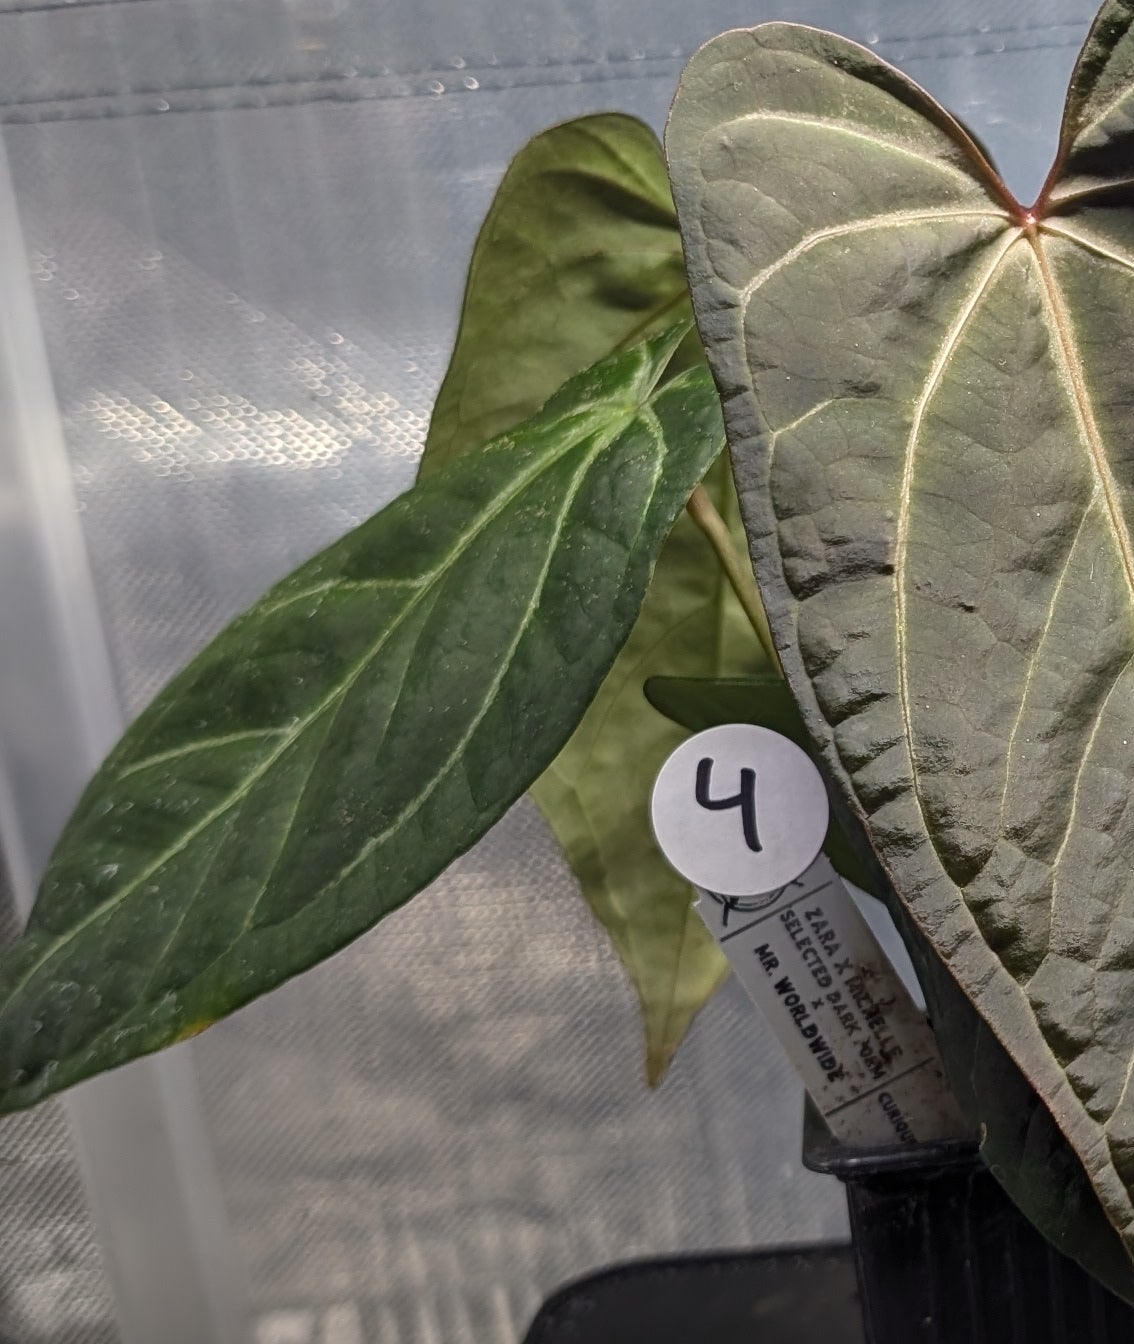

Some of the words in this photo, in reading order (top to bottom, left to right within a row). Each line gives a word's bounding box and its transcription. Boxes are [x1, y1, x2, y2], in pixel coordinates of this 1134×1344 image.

[695, 757, 763, 852] 4
[781, 910, 832, 988] SELECTED
[827, 991, 862, 1036] DARK
[805, 908, 841, 956] ZARA
[754, 944, 780, 977] MR.
[774, 976, 845, 1083] WORLDWIDE
